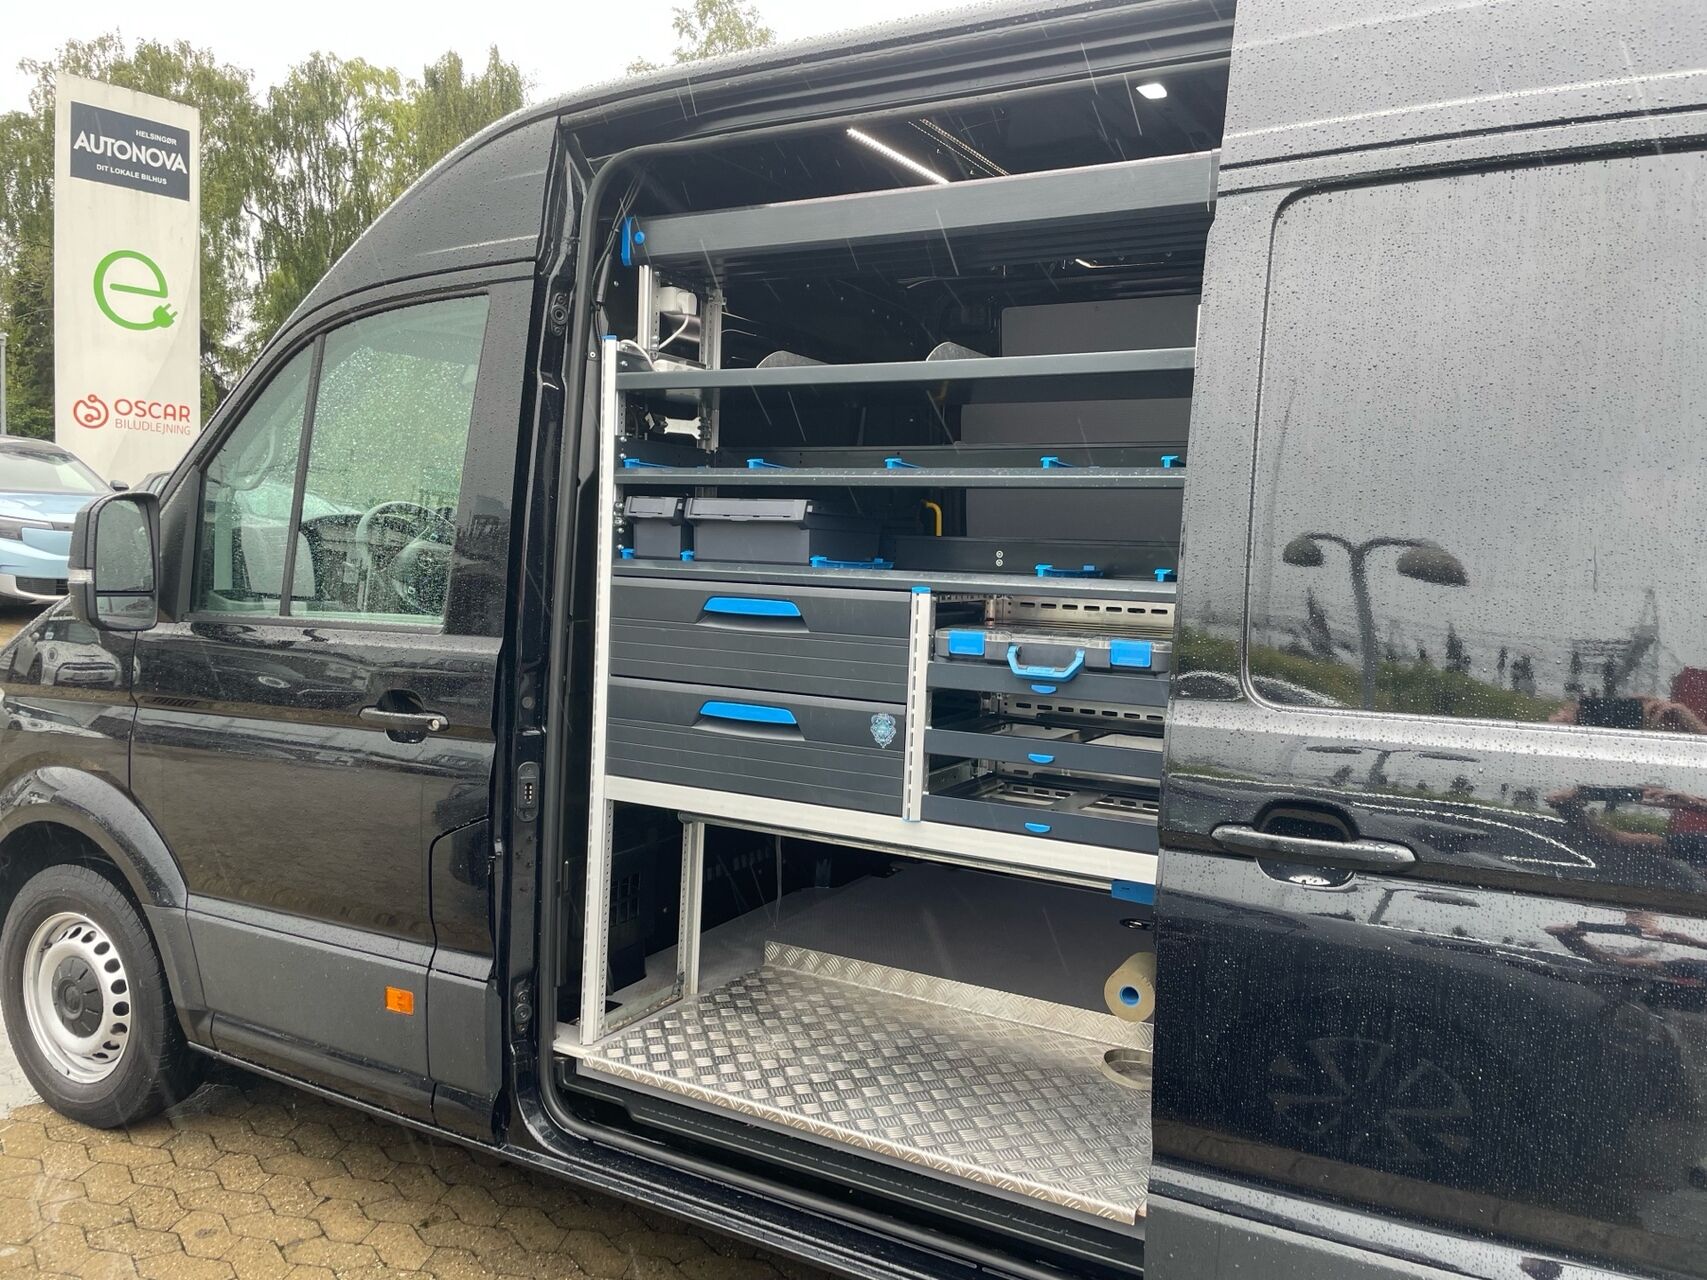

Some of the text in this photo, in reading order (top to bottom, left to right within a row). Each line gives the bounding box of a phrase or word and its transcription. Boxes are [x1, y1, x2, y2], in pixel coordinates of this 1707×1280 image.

[135, 129, 177, 146] HELSINGØR
[73, 130, 188, 174] AUTONOVA
[96, 163, 167, 185] DIT LOKALE BILHUS
[114, 399, 191, 423] OSCAR
[115, 418, 191, 436] BILUDLEJNING
